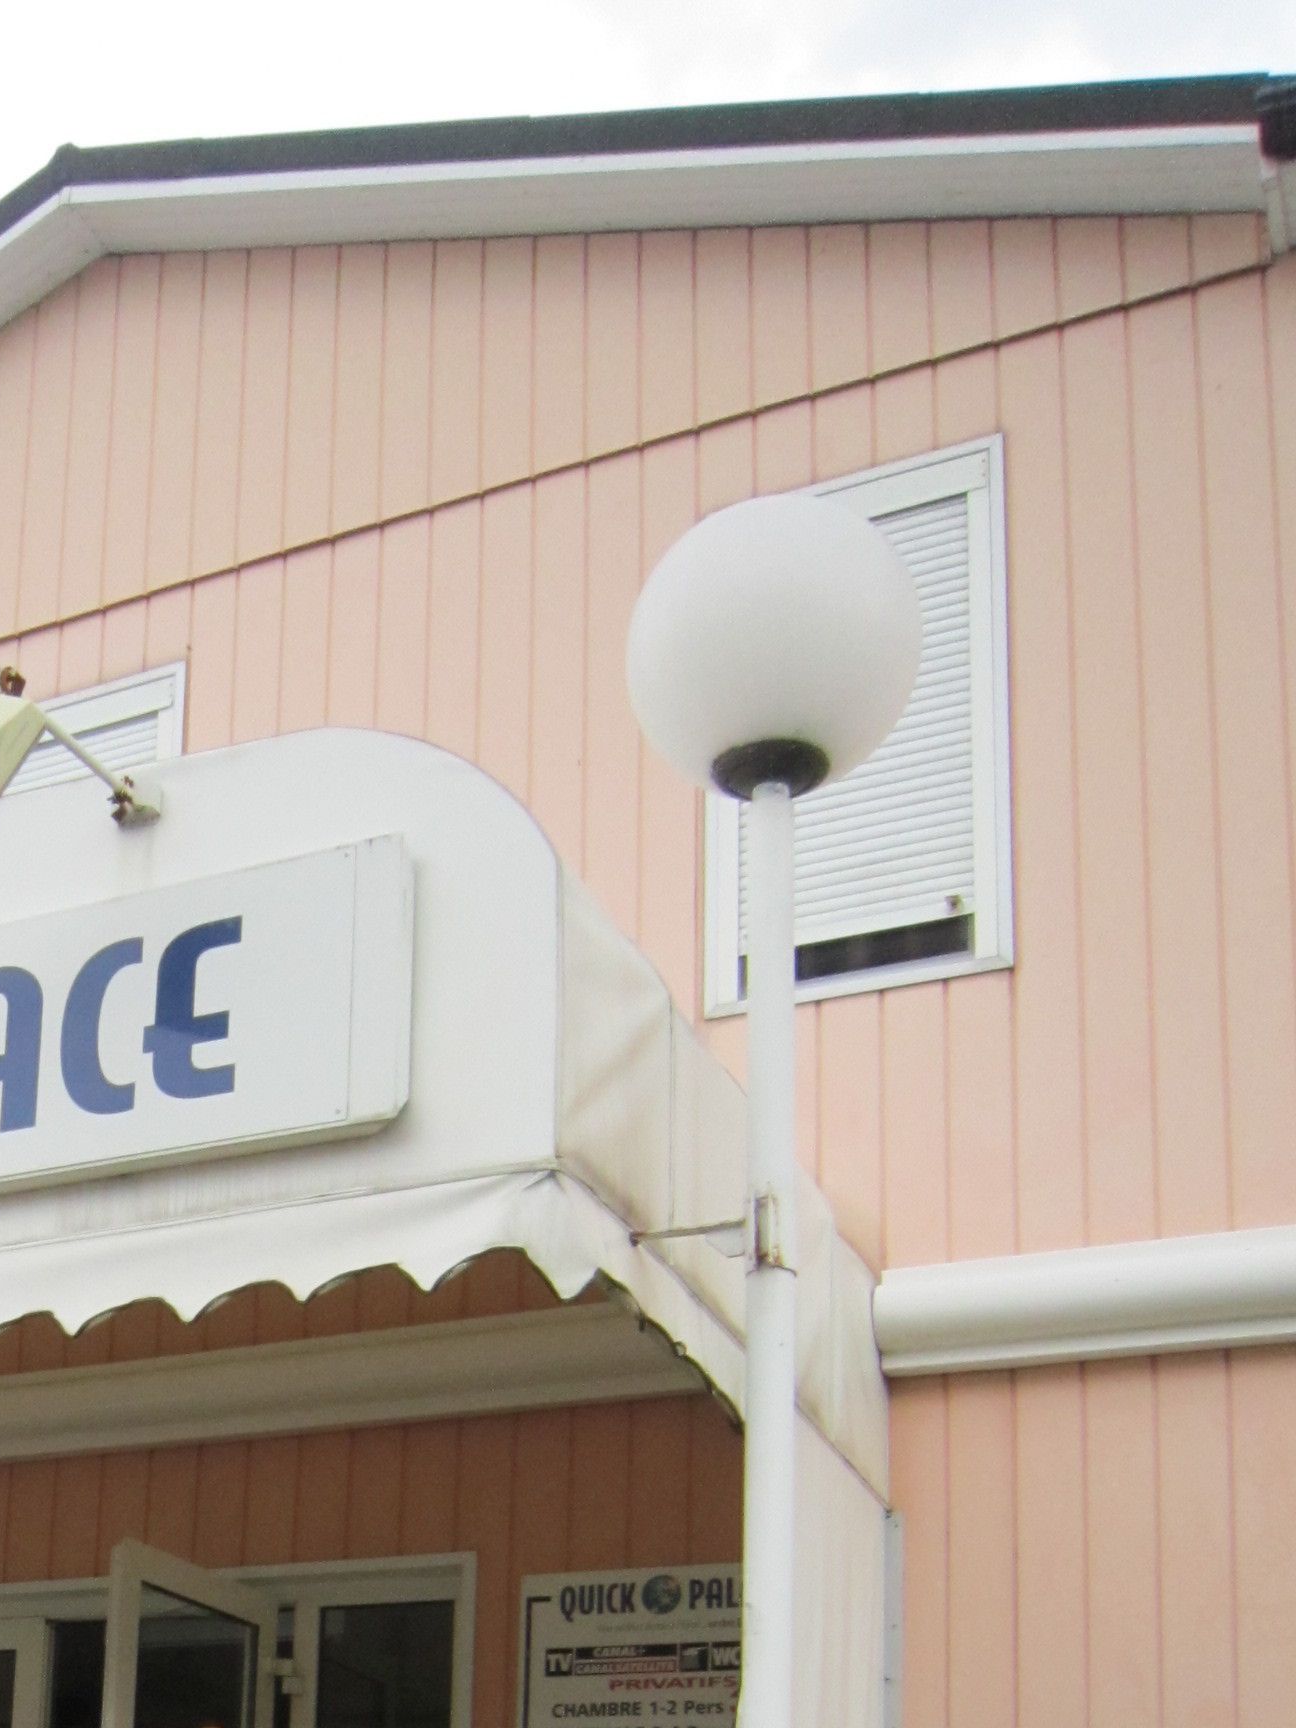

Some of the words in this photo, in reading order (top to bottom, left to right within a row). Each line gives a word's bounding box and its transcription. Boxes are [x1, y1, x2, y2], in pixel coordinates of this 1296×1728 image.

[559, 1582, 637, 1622] QUICK
[688, 1577, 740, 1611] PAL
[547, 1652, 573, 1672] TV
[608, 1675, 738, 1691] PRIVATIFS
[551, 1701, 642, 1718] CHAMBRE
[650, 1700, 677, 1716] 1-2
[684, 1700, 724, 1715] Pers
